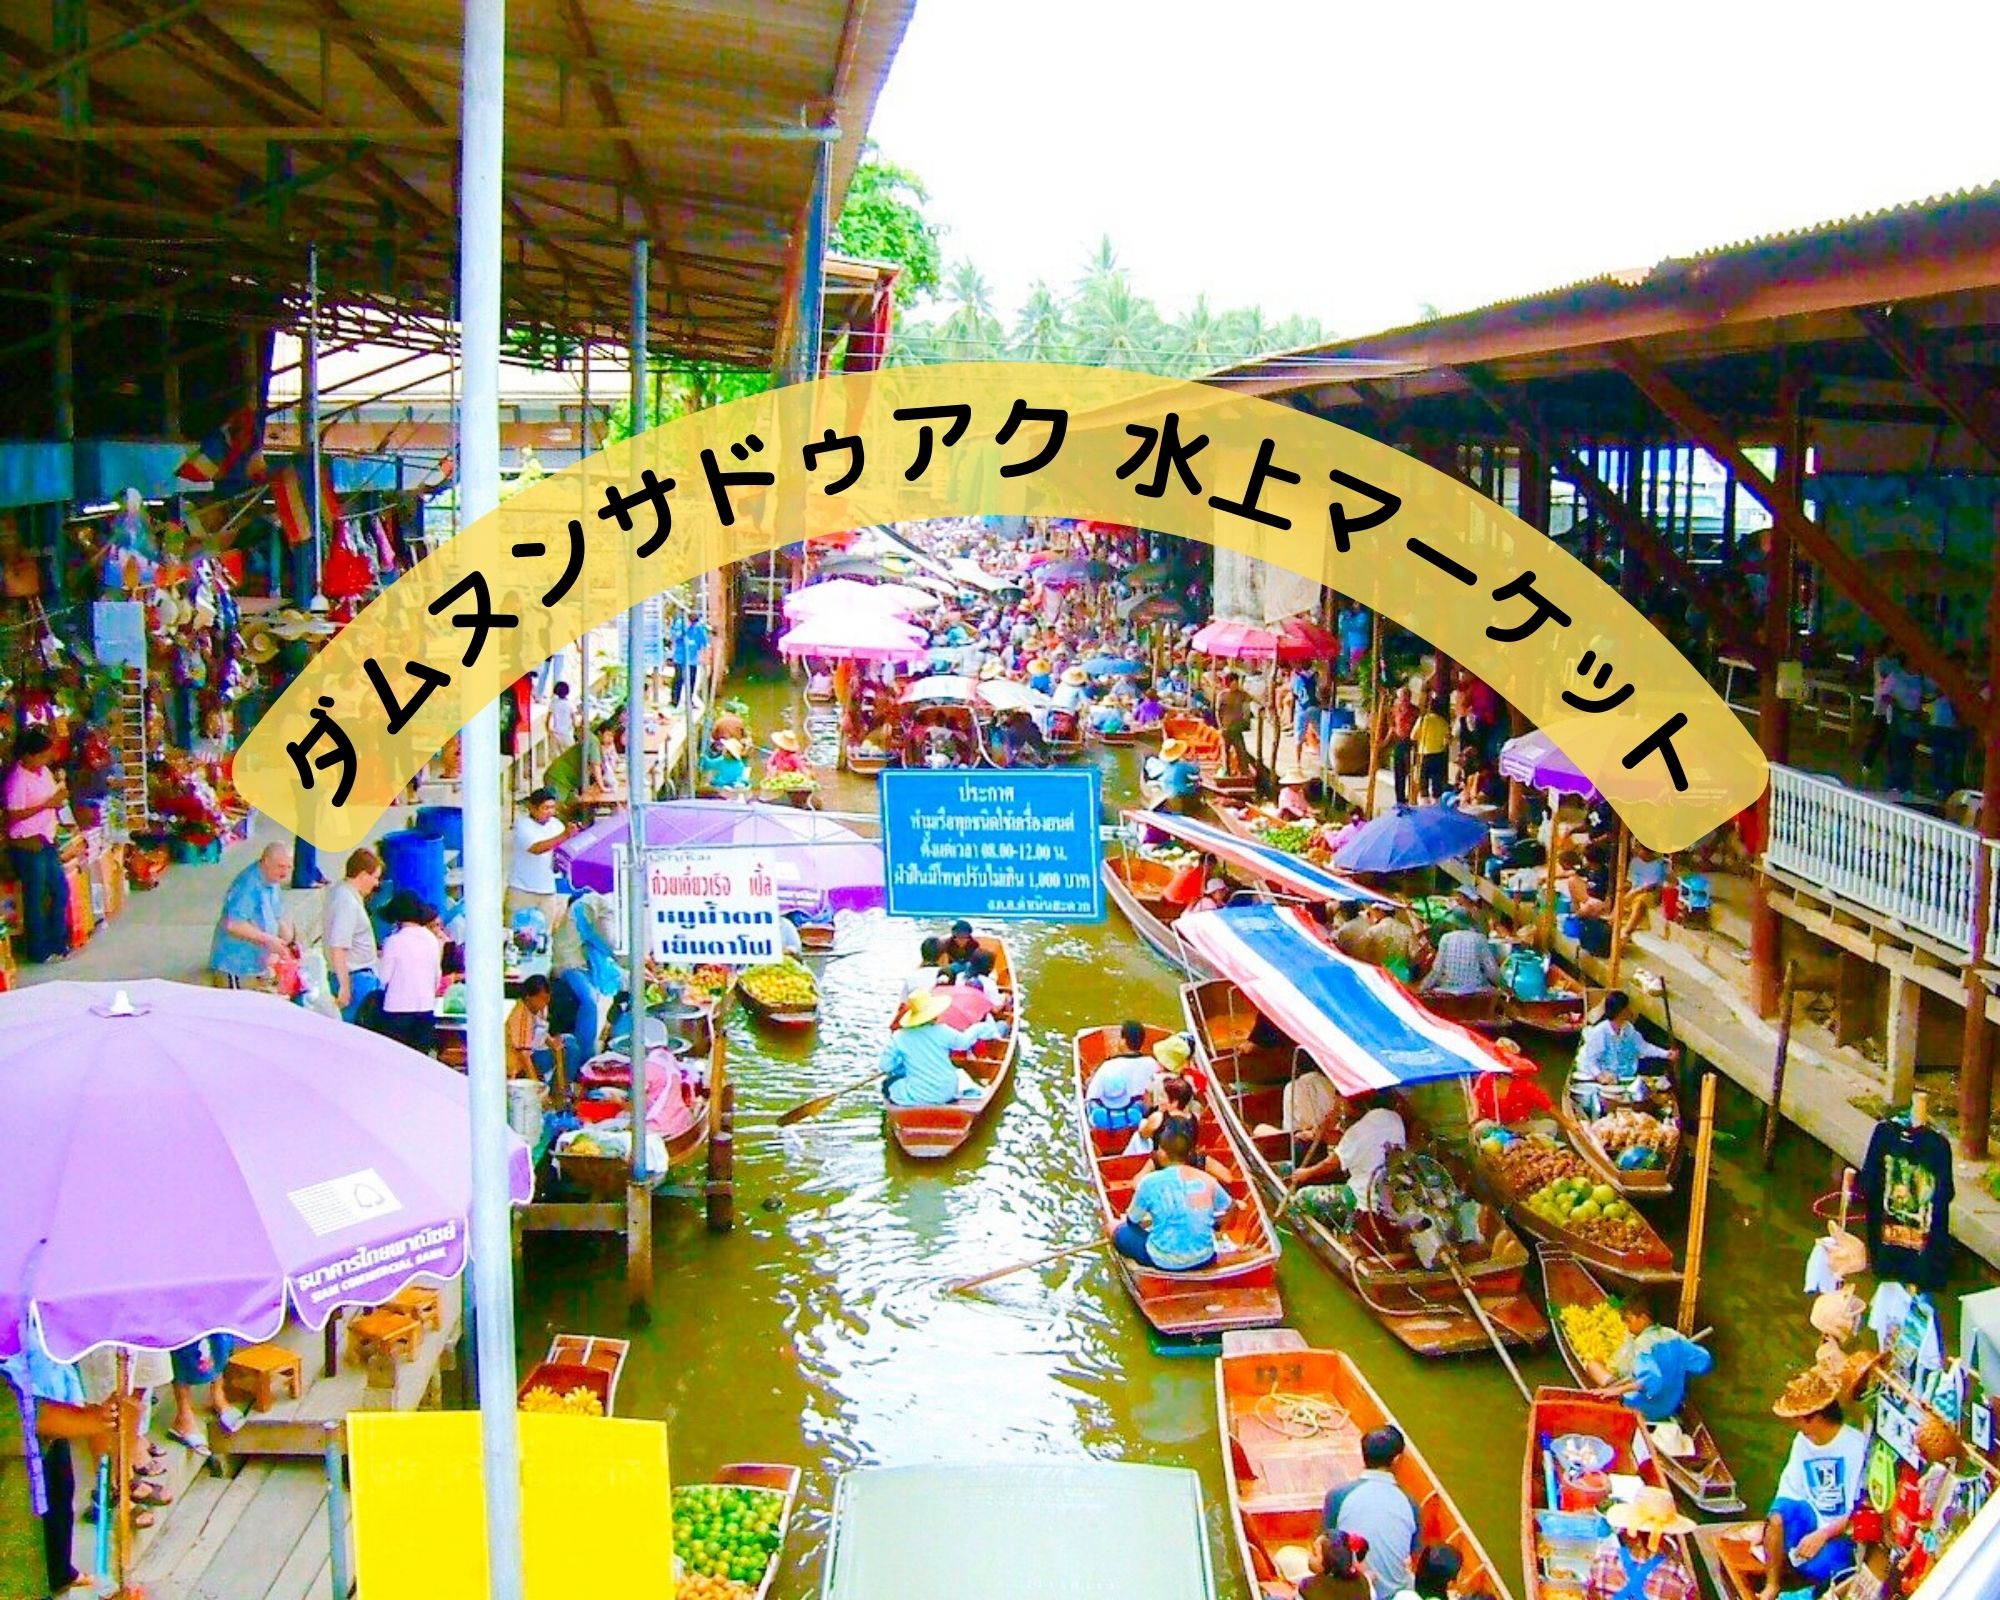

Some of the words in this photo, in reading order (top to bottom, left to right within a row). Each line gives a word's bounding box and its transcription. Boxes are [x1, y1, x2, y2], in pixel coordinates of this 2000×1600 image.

[958, 778, 1014, 802] ประกาศ
[1063, 872, 1091, 889] บาท
